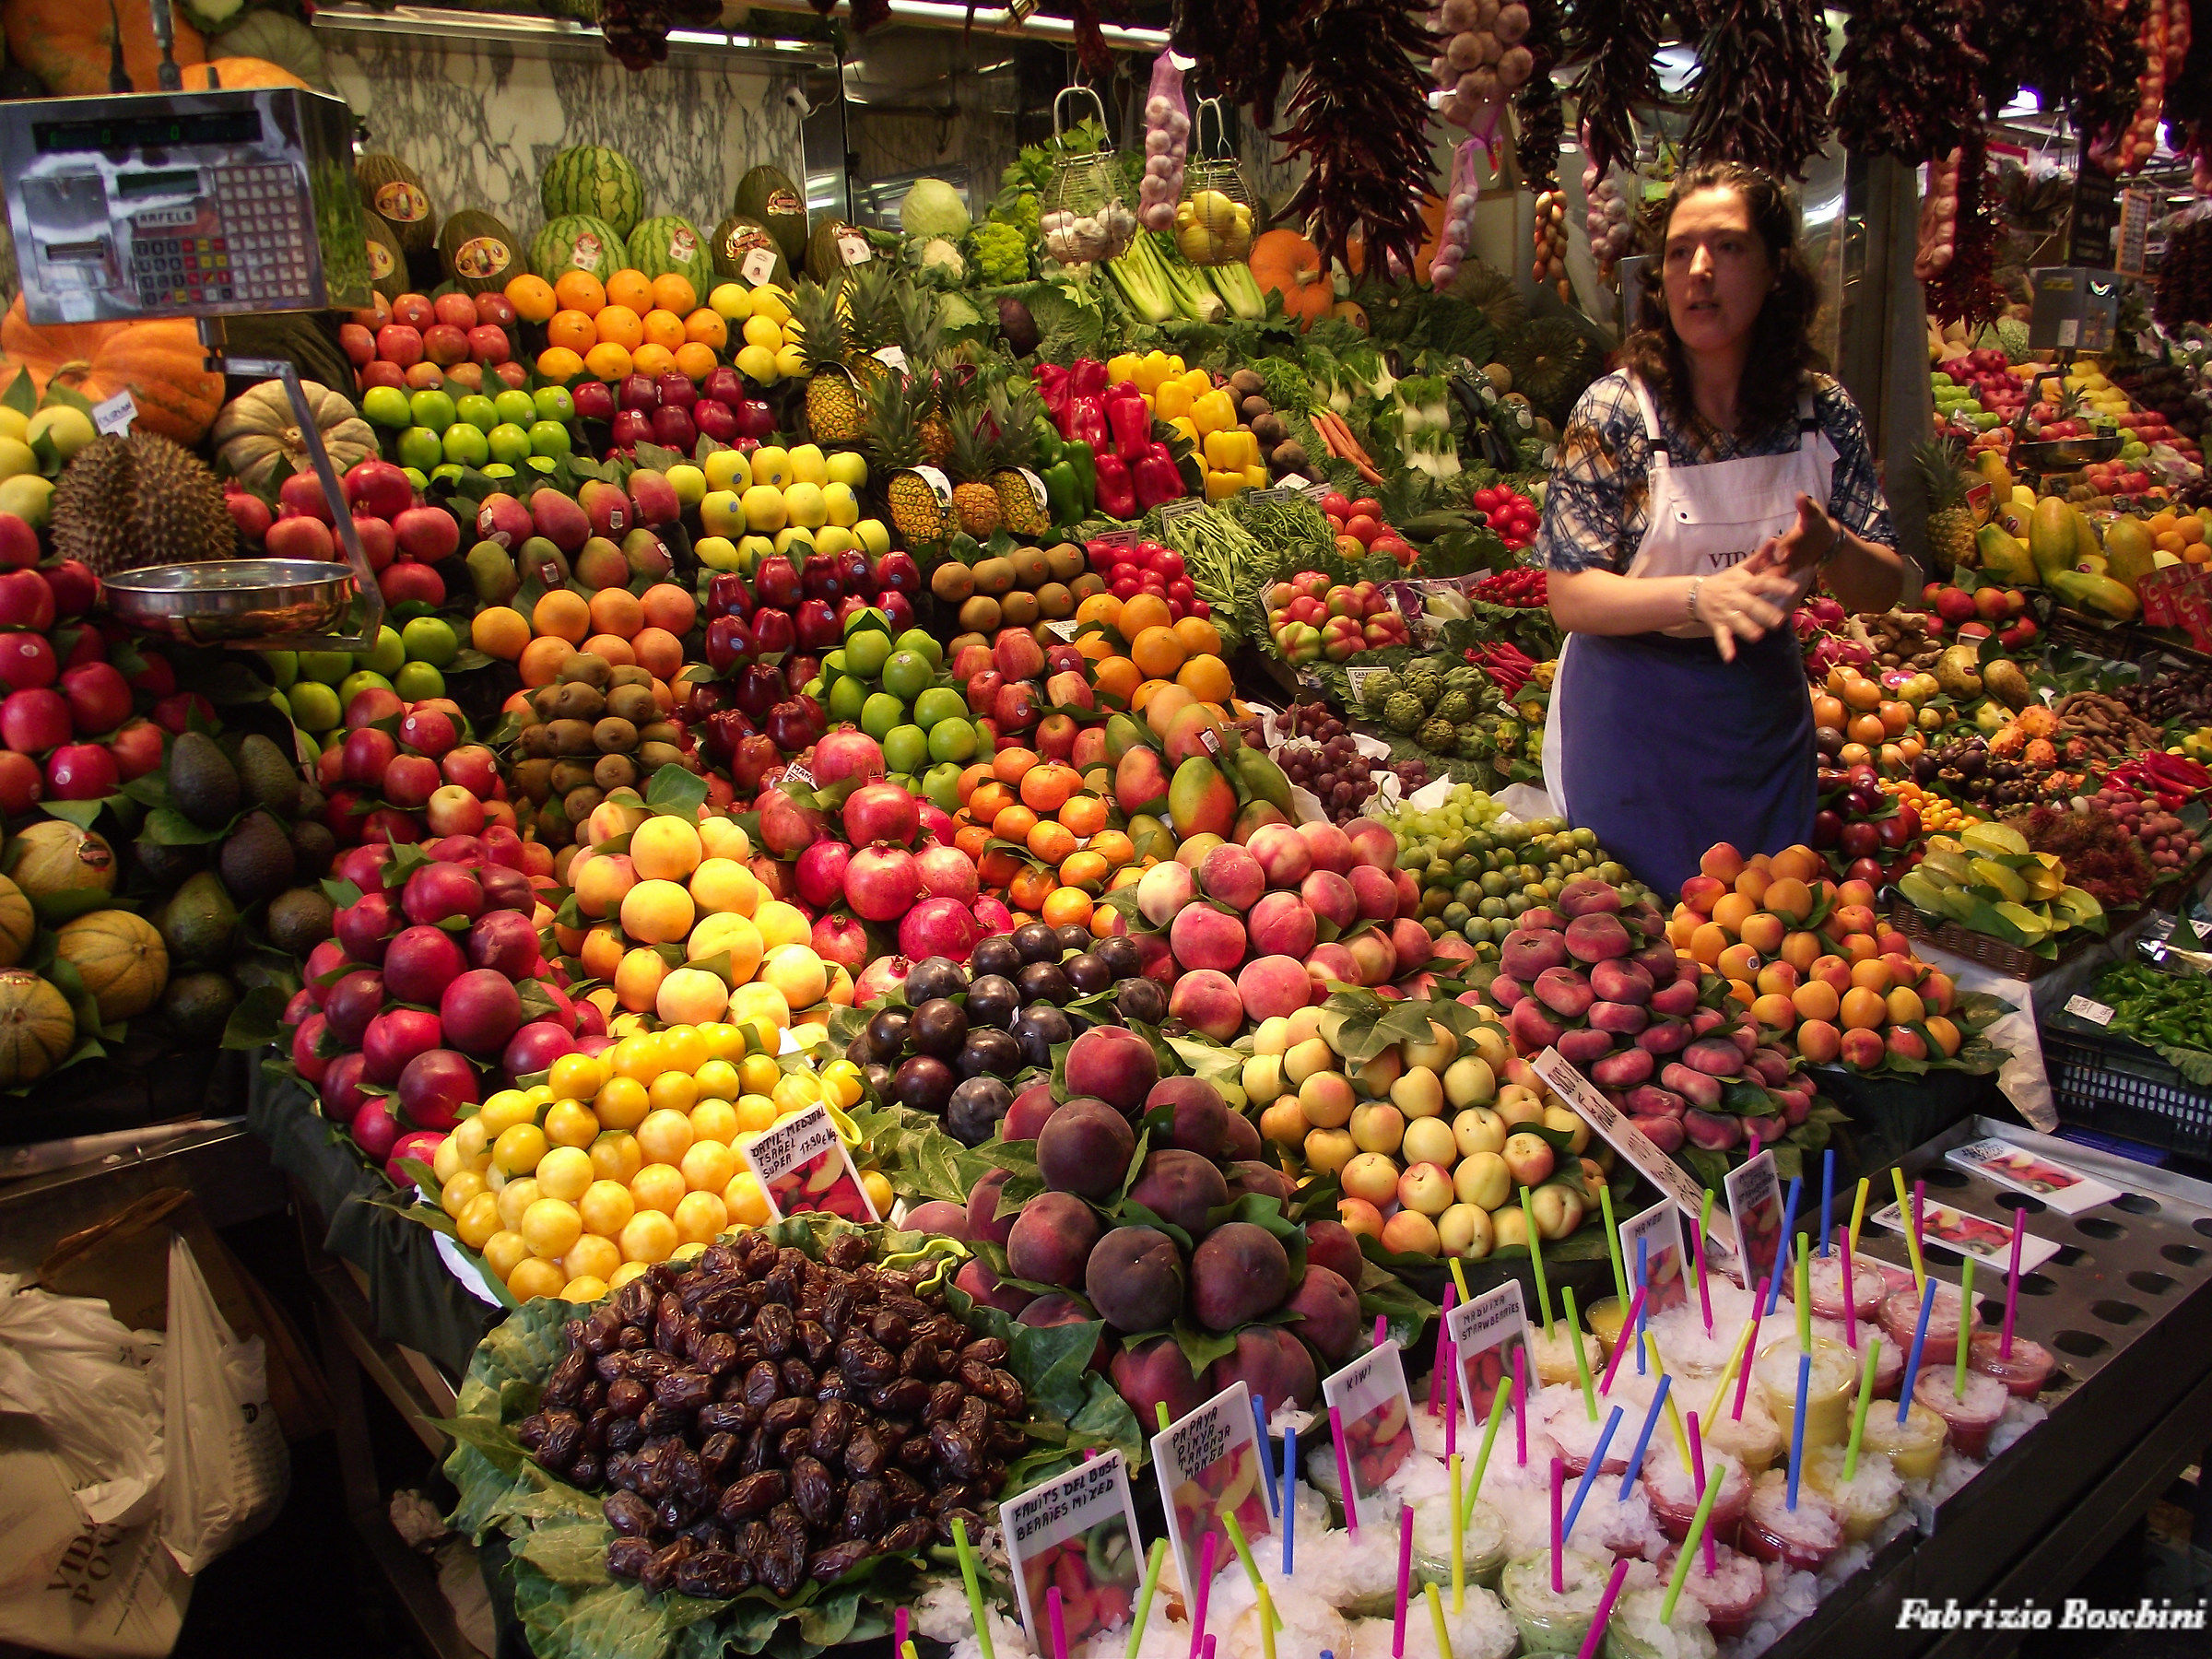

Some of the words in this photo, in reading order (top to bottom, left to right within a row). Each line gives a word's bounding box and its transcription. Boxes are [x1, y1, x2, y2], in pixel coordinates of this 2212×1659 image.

[758, 1137, 796, 1167] ISRAEL
[762, 1154, 793, 1179] SUPER
[1185, 1442, 1224, 1480] MANGO
[1063, 1476, 1086, 1496] DEL
[1017, 1501, 1069, 1541] BERRIES
[1072, 1478, 1114, 1510] MIXED
